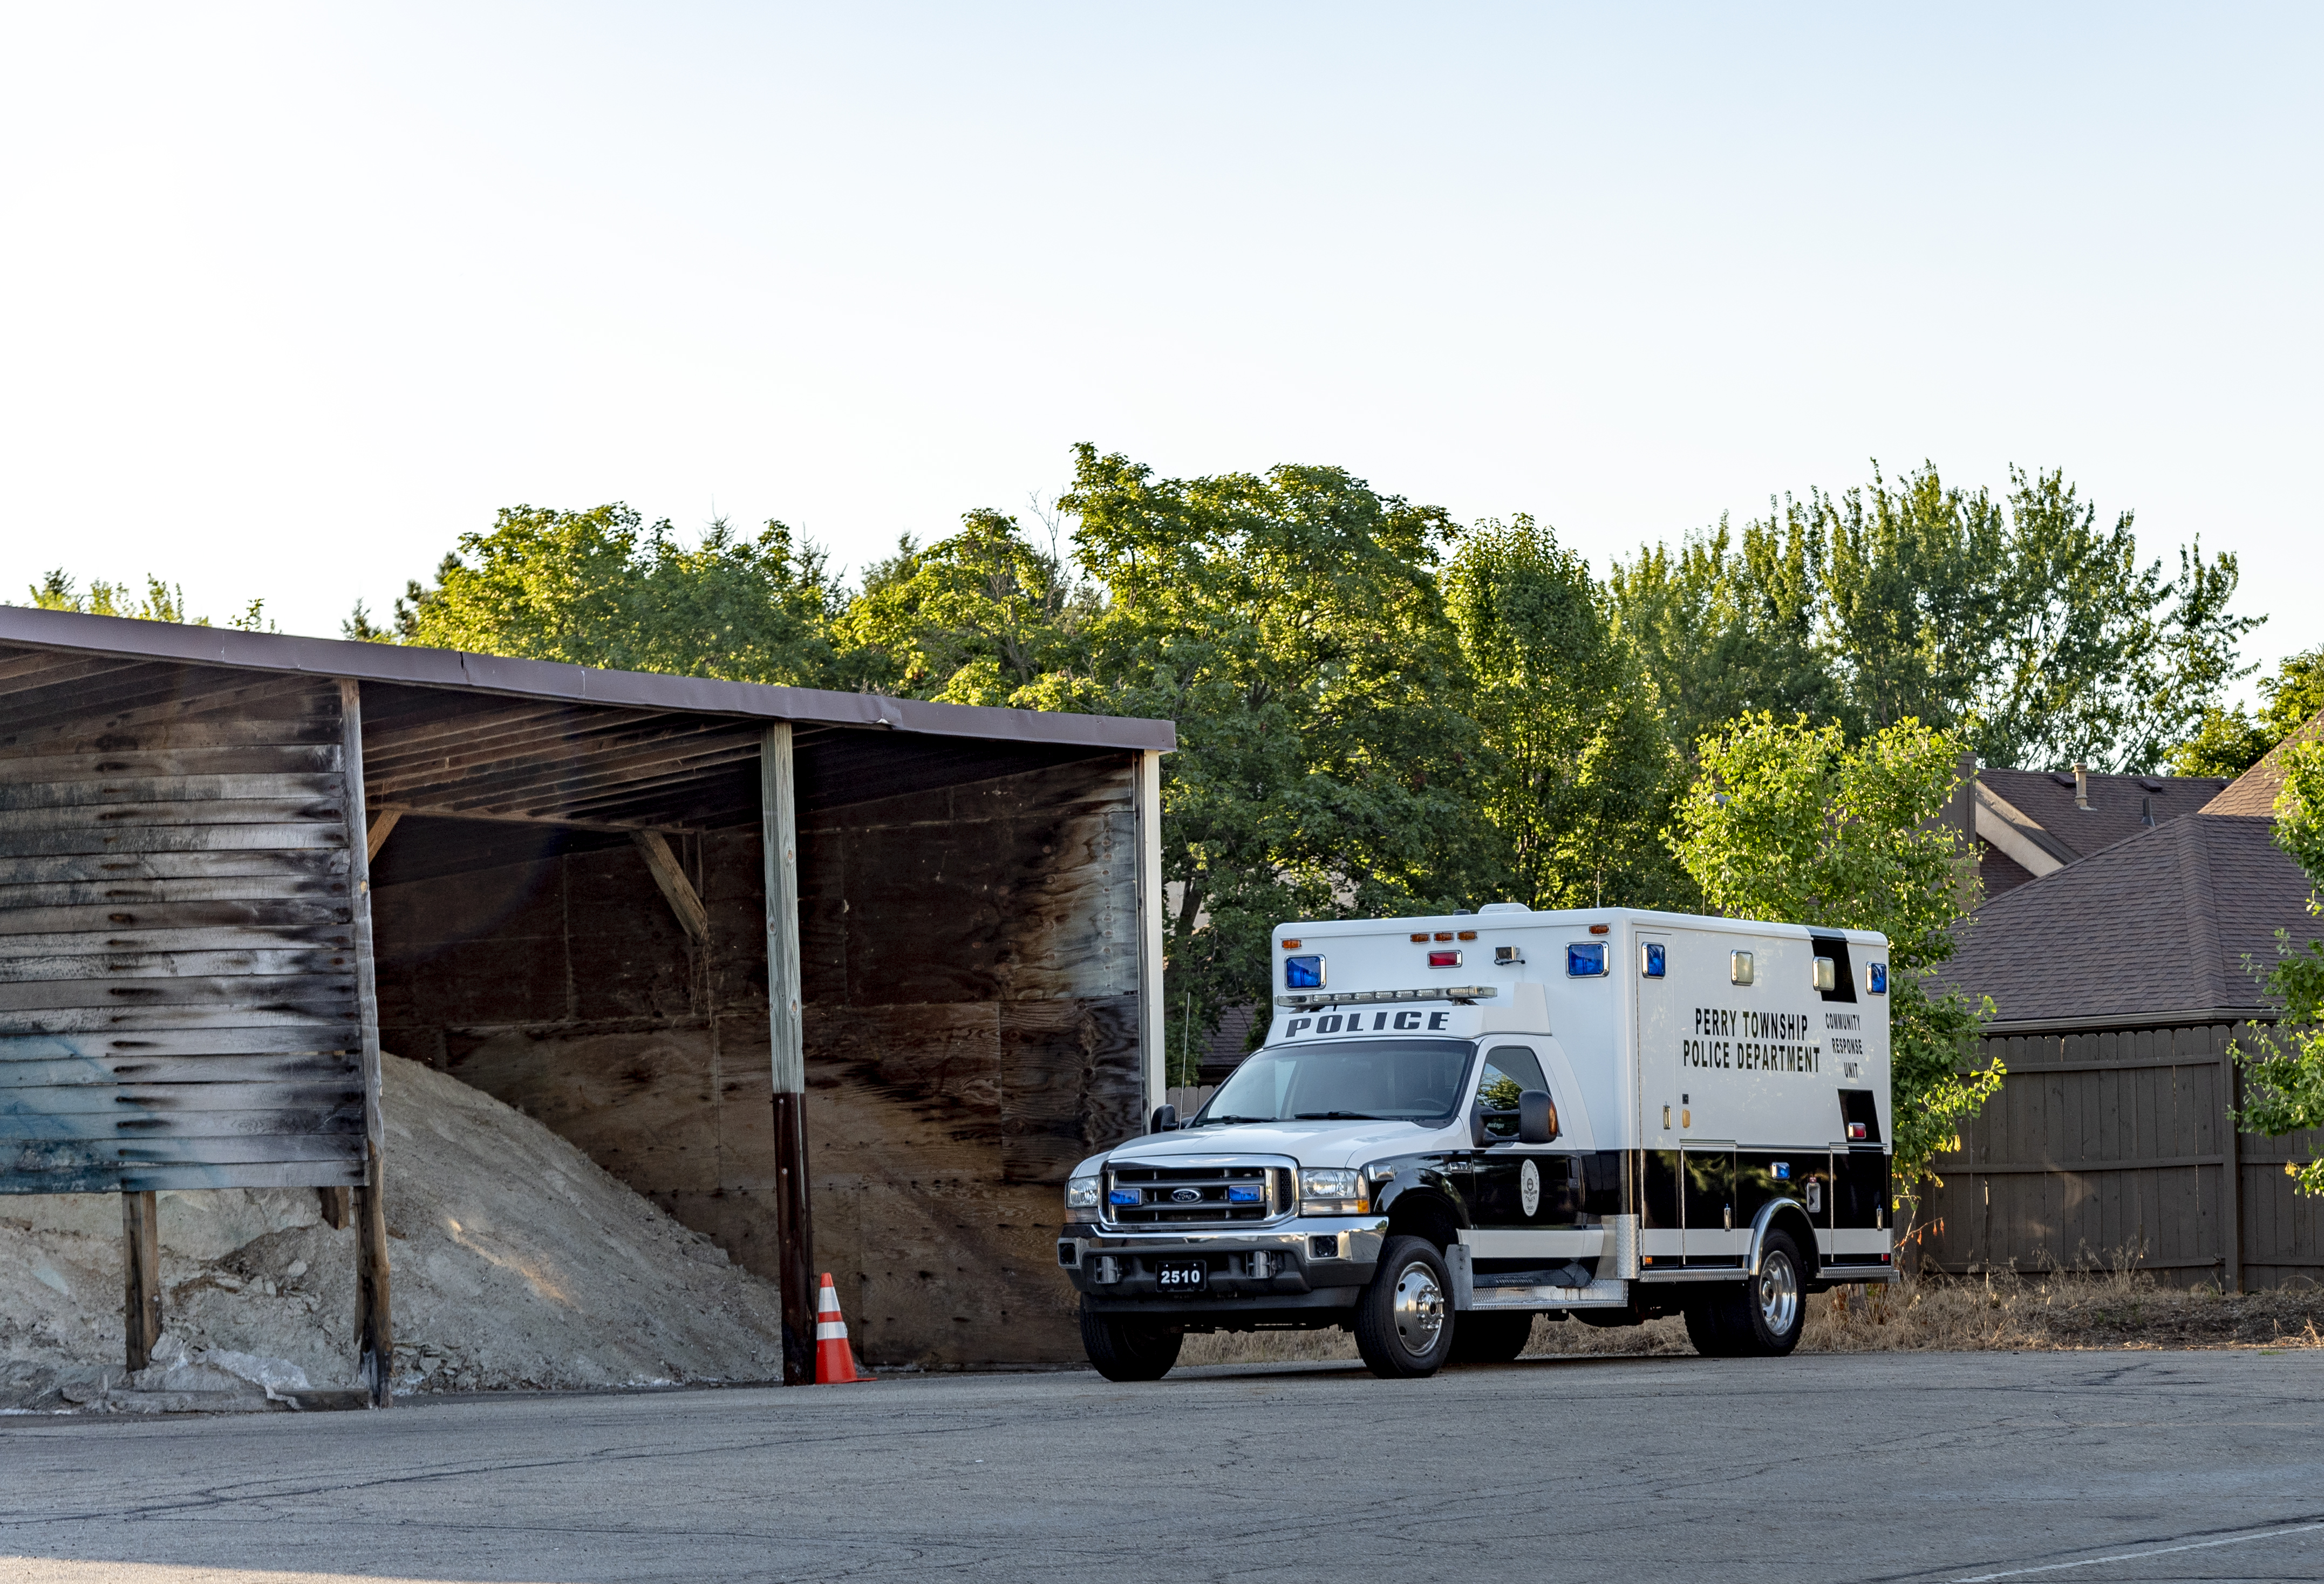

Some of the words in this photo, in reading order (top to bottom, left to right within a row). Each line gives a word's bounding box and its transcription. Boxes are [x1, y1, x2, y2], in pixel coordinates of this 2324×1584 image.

[1285, 1011, 1450, 1038] POLICE
[1695, 1007, 1737, 1037] PERRY
[1742, 1011, 1808, 1041] TOWNSHIP
[1825, 1013, 1860, 1031] COMMUNITY
[1831, 1037, 1863, 1055] RESPONSE
[1683, 1039, 1730, 1069] POLICE
[1737, 1042, 1820, 1073] DEPARTMENT
[1843, 1062, 1859, 1078] UNIT
[1177, 1192, 1192, 1200] Ford
[1161, 1269, 1200, 1283] 2510
